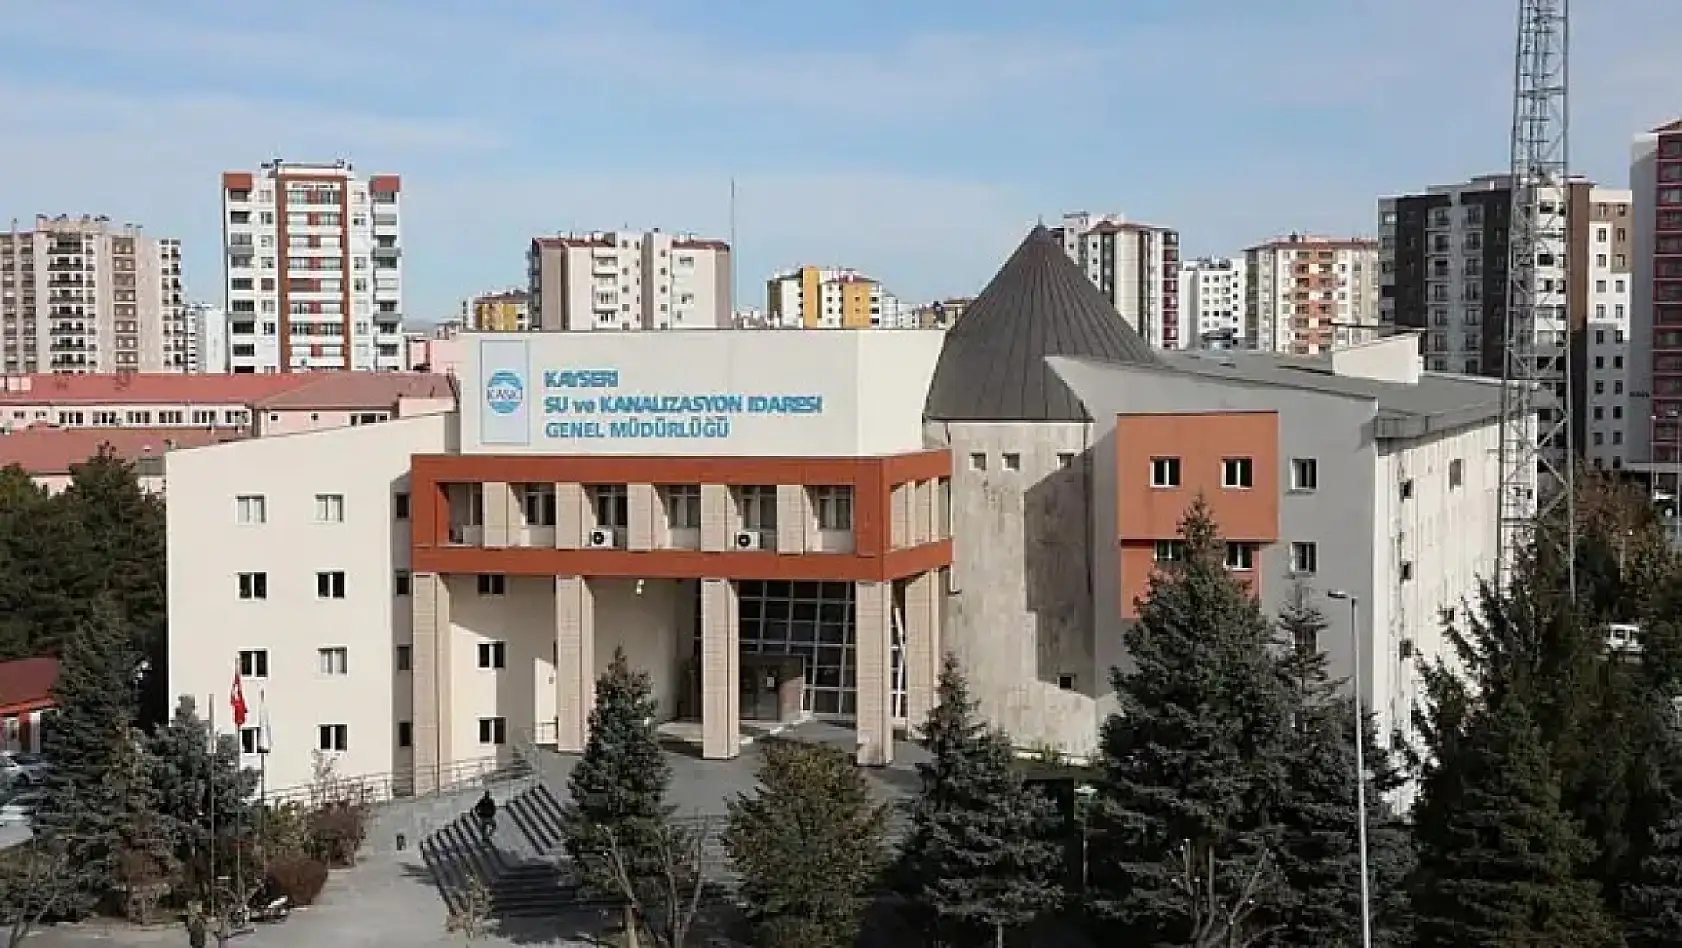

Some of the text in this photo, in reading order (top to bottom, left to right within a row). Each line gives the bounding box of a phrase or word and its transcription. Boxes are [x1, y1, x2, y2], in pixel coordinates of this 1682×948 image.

[545, 396, 569, 413] SU
[572, 400, 595, 413] ve
[546, 416, 728, 438] GENEL MÜDÜRLÜĞÜ
